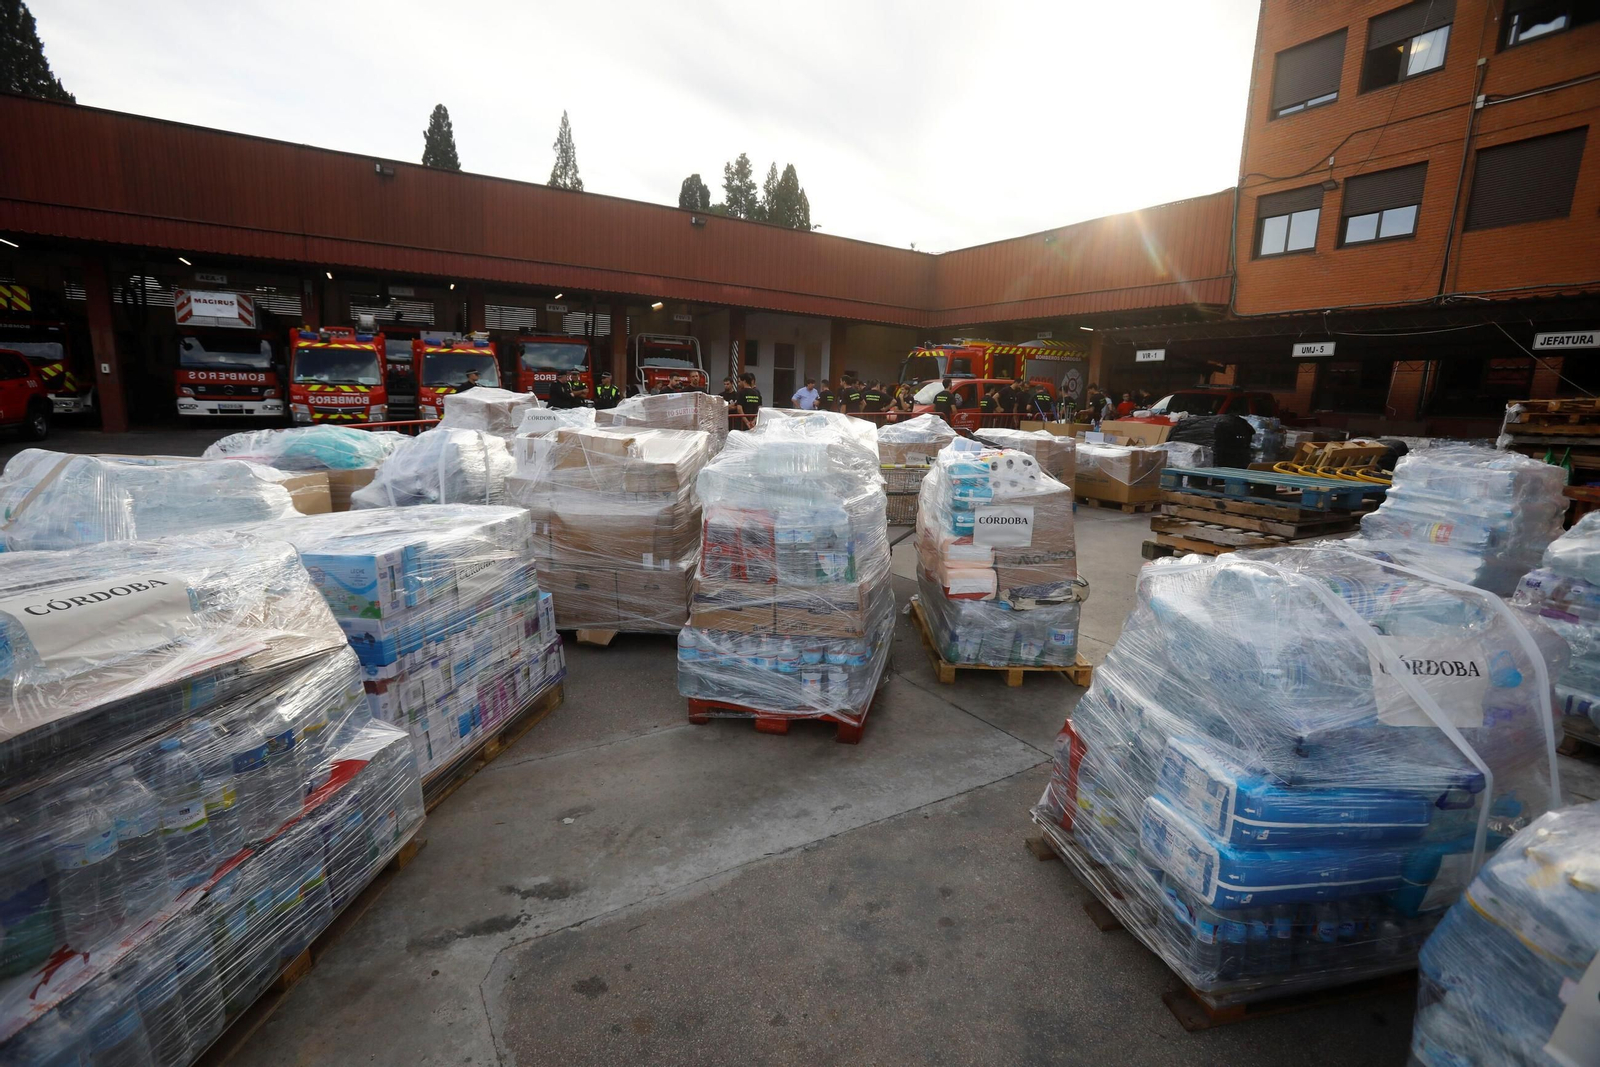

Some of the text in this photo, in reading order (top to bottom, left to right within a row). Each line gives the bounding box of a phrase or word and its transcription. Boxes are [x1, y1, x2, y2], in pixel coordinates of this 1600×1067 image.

[194, 298, 235, 306] MAGIRUS
[1540, 335, 1594, 346] JEFATURA
[978, 515, 1029, 525] CÓRDOBA
[24, 578, 168, 617] CÓRDOBA
